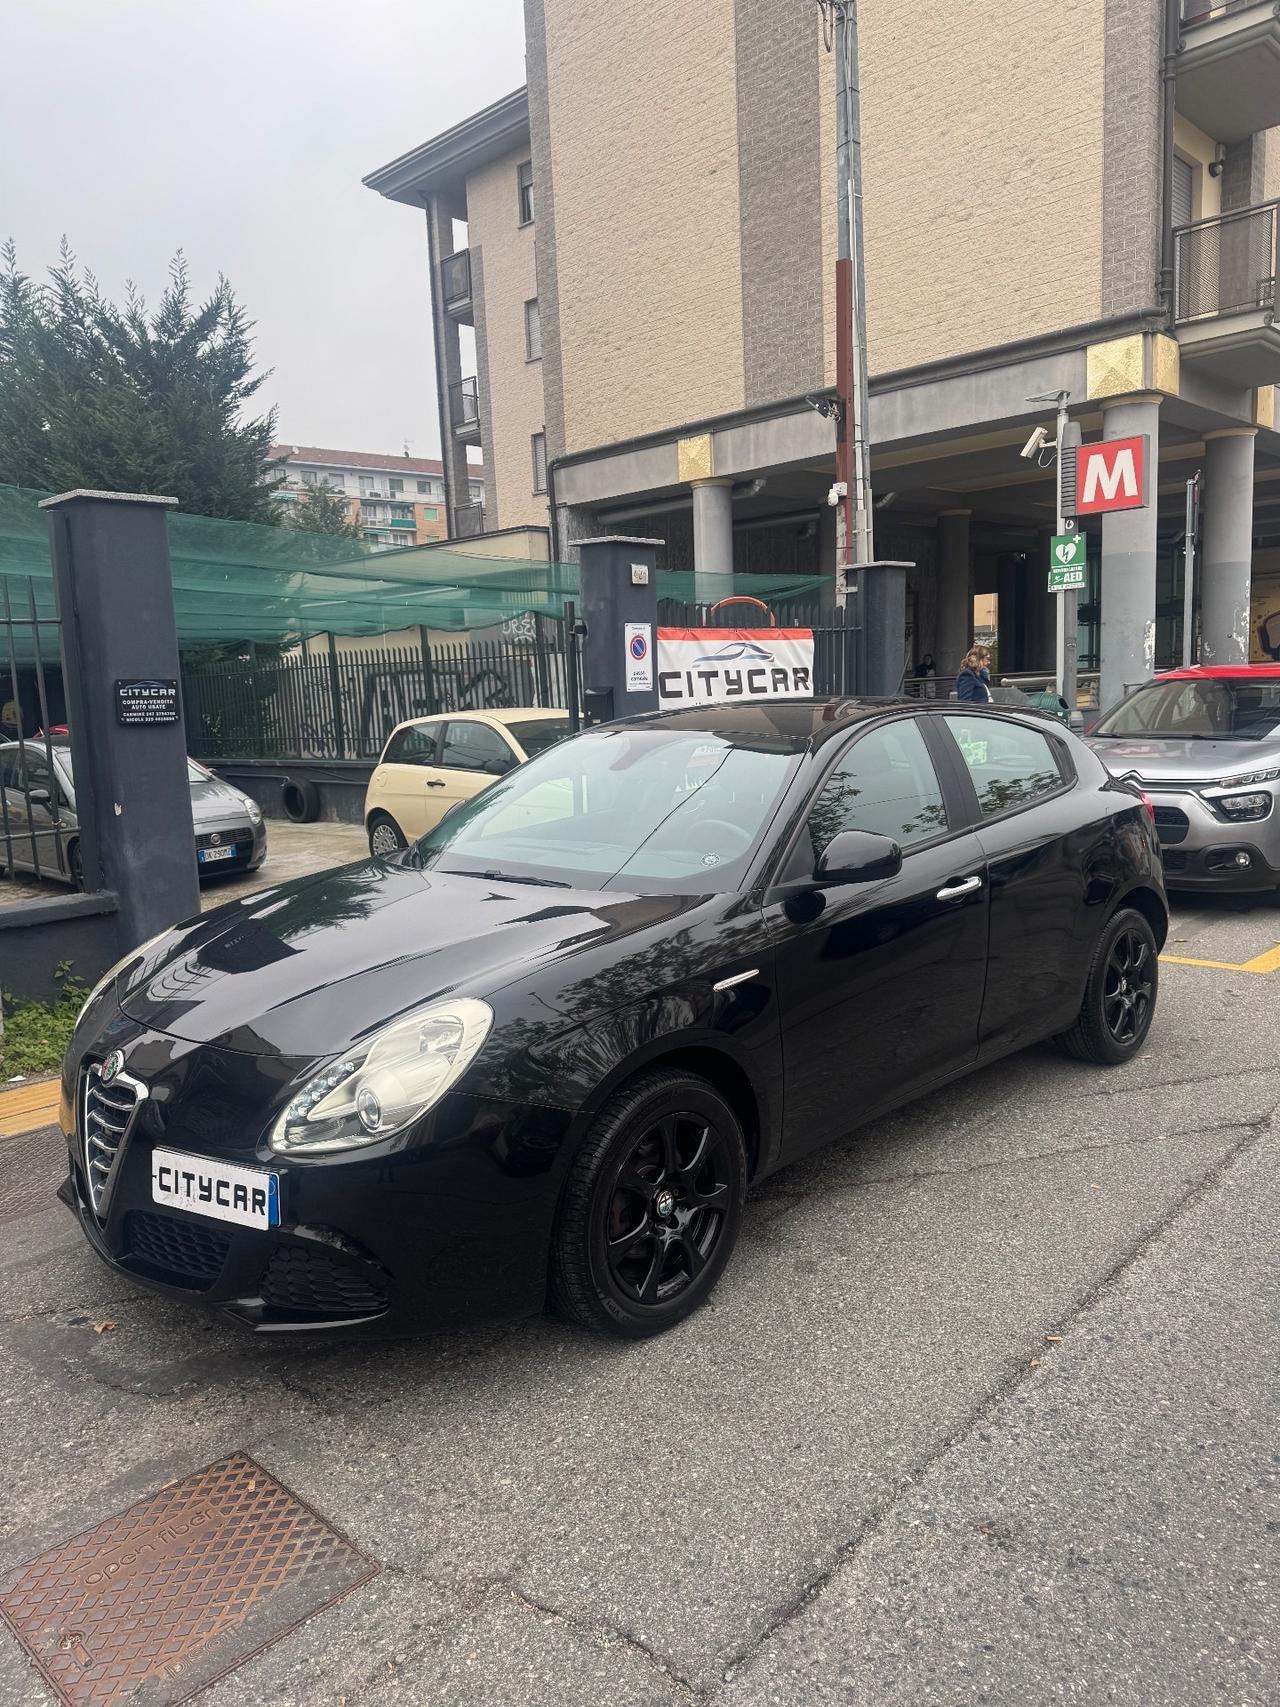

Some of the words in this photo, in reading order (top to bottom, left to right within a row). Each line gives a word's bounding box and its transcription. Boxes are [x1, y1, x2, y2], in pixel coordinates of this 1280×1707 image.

[1082, 449, 1138, 503] M
[1063, 571, 1083, 583] AED
[119, 688, 176, 696] CITYCAR
[658, 667, 810, 699] CITYCAR
[158, 1166, 266, 1216] CITYCAR
[85, 1544, 156, 1584] open
[158, 1509, 214, 1544] fiber
